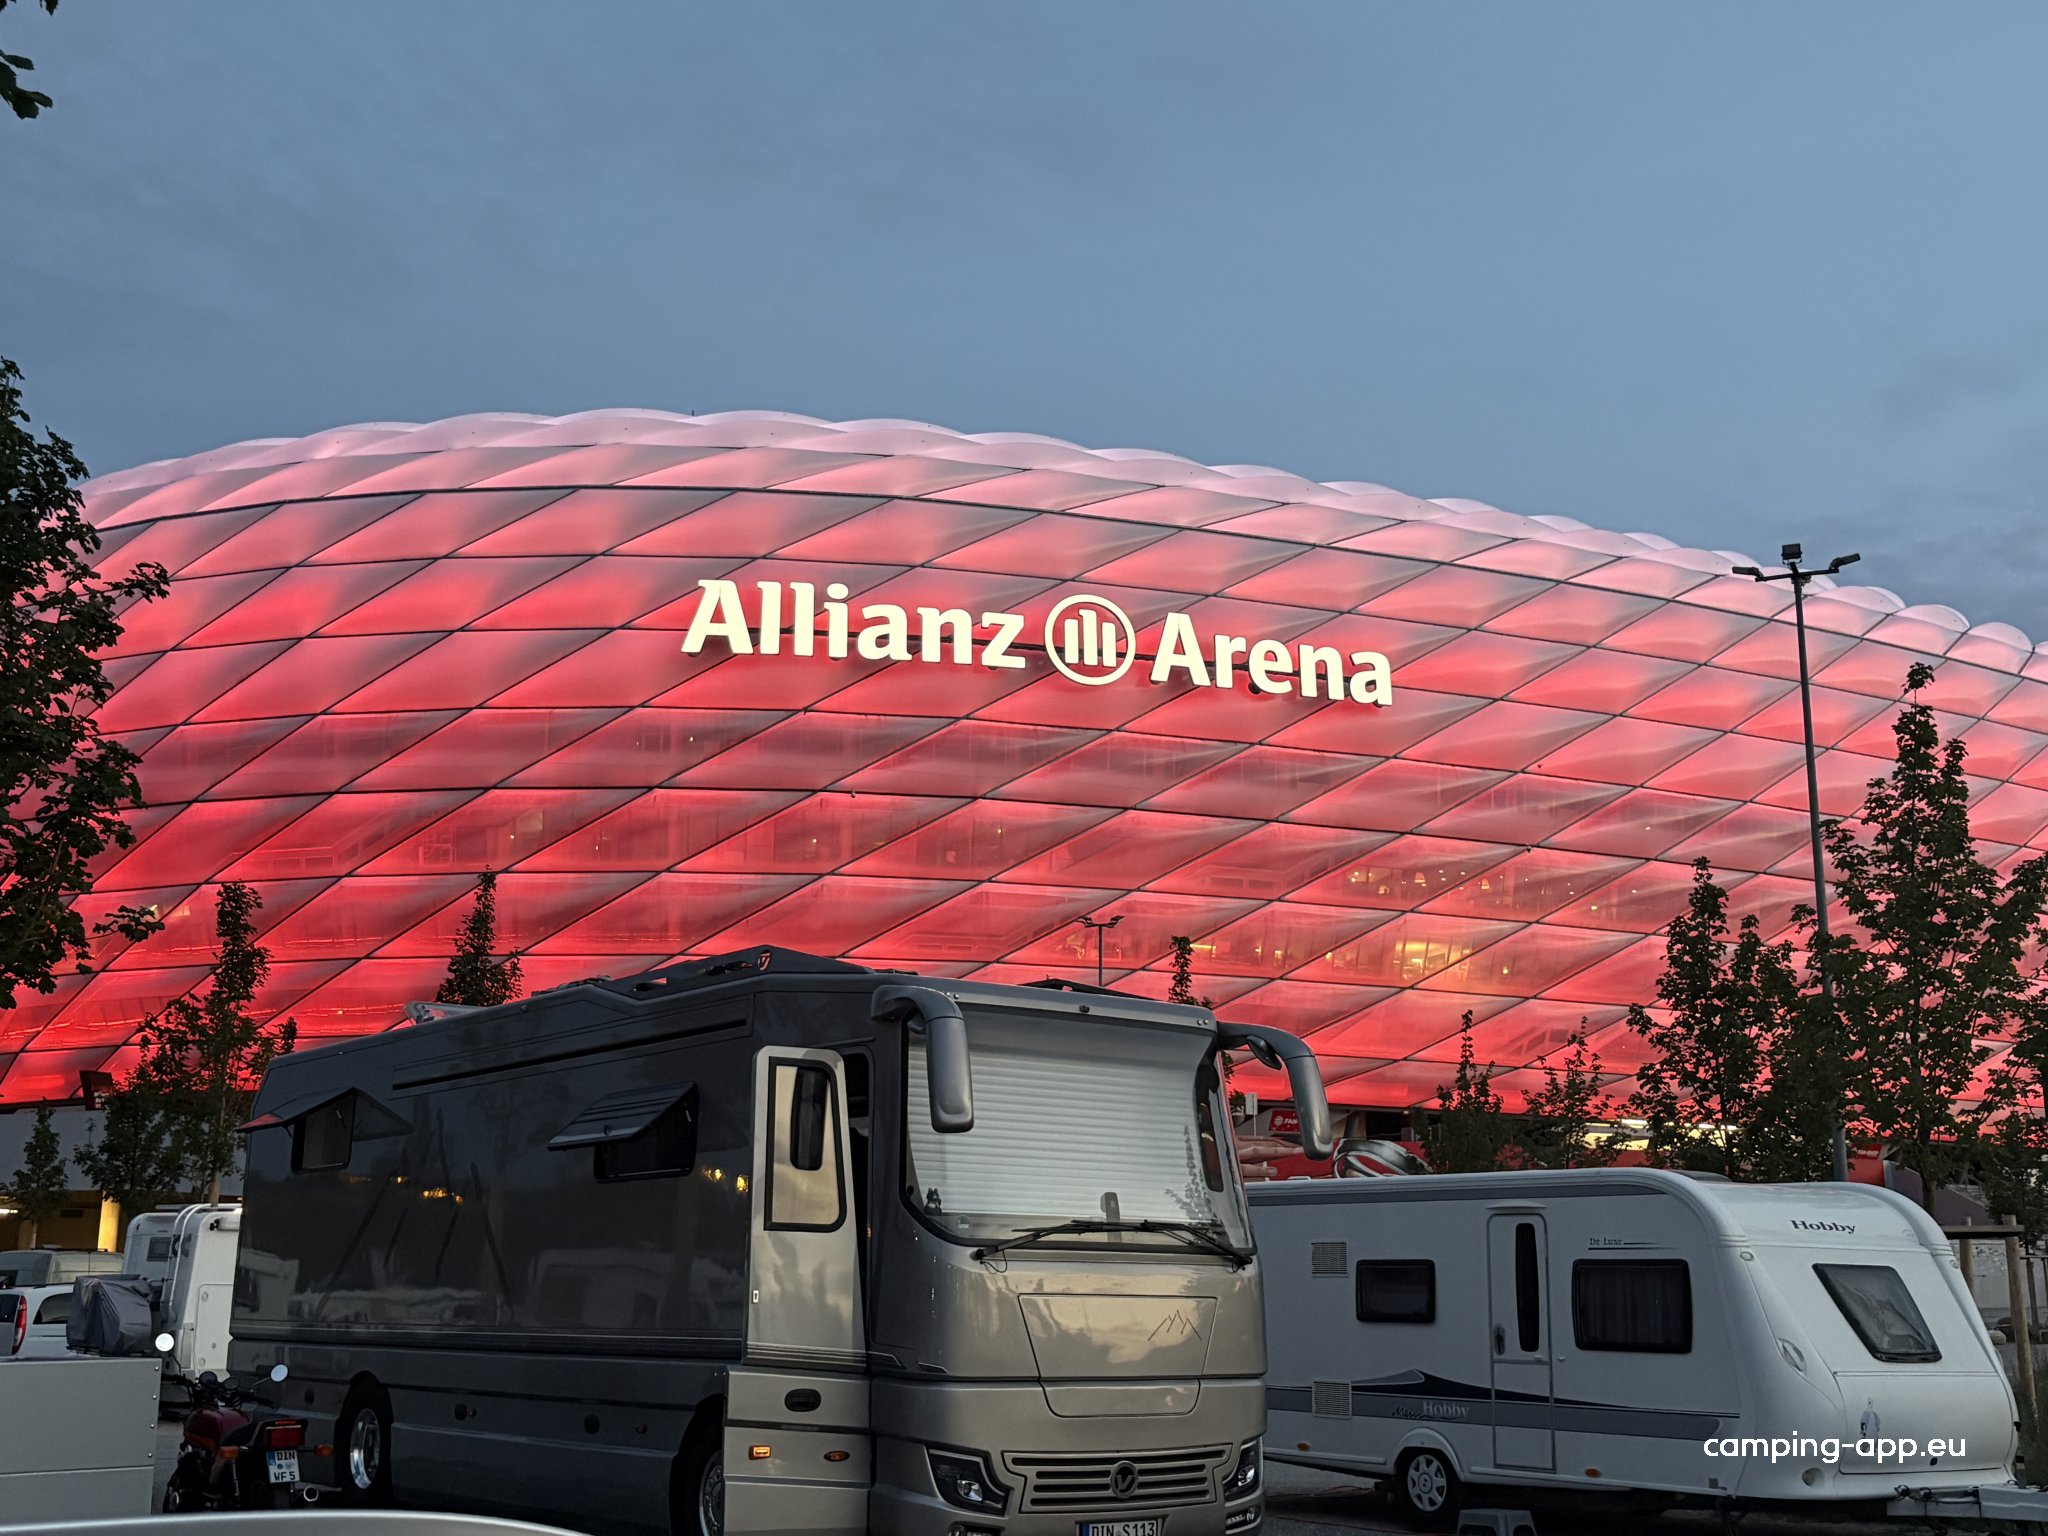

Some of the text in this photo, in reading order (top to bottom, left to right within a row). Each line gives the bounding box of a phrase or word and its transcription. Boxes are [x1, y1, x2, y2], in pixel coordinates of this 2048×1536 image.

[681, 579, 1394, 706] Allianz Arena
[1790, 1220, 1856, 1234] Hobby
[1422, 1400, 1469, 1417] Hobby
[276, 1451, 296, 1460] DIN
[1092, 1525, 1114, 1536] DIN
